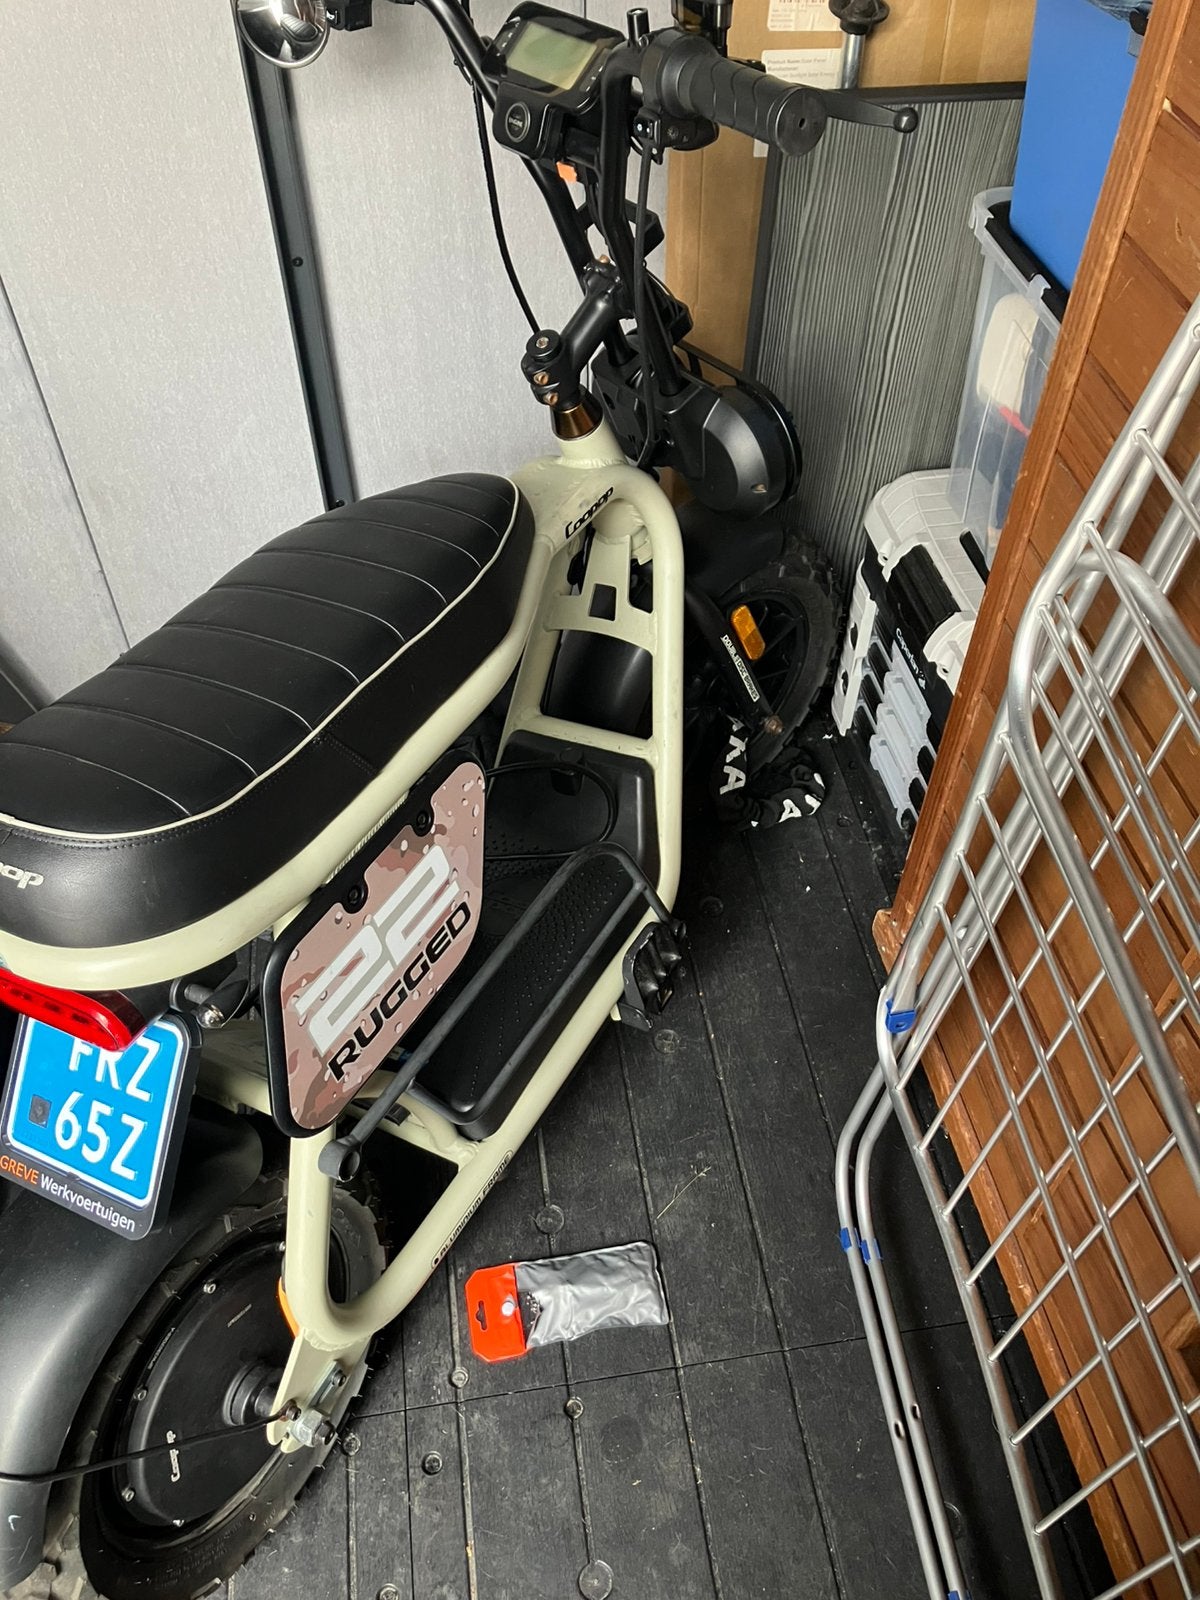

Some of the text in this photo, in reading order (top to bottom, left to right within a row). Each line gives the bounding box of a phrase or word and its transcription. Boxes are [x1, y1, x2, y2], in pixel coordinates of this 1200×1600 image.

[327, 901, 471, 1082] RUGGED
[69, 1036, 162, 1102] FRZ
[54, 1091, 147, 1181] 65Z
[0, 1154, 136, 1233] GREVE Werkvoertuigen
